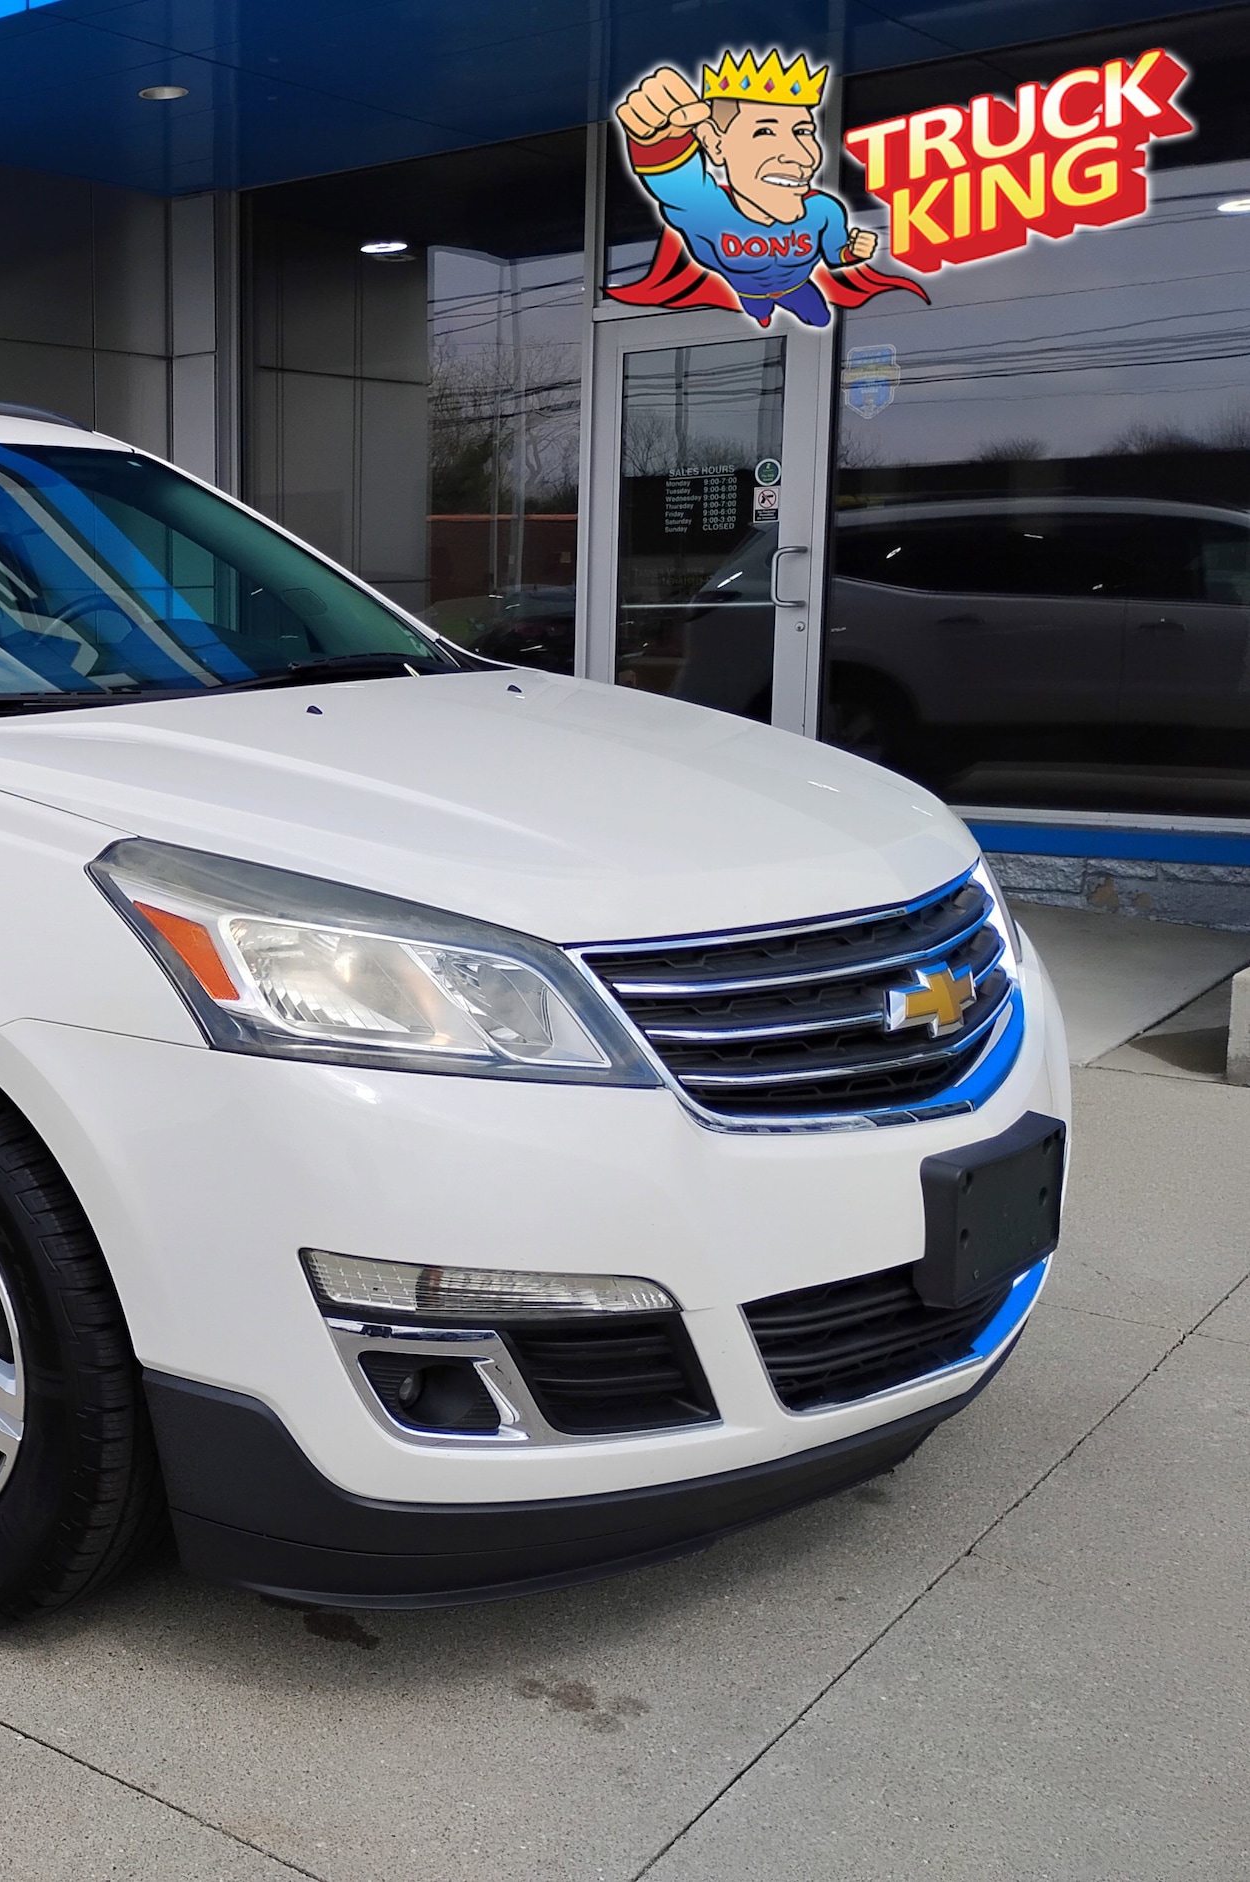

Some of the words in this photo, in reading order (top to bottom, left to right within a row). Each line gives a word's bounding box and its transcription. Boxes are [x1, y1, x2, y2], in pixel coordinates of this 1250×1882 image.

[669, 467, 699, 478] SALES
[701, 465, 735, 475] HOURS
[666, 480, 691, 488] Monday
[666, 488, 691, 496] Tuesday
[665, 495, 702, 503] Wednesday
[665, 510, 685, 518] Friday
[664, 518, 692, 526] Saturday
[664, 525, 688, 534] Sunday
[702, 523, 735, 531] CLOSED
